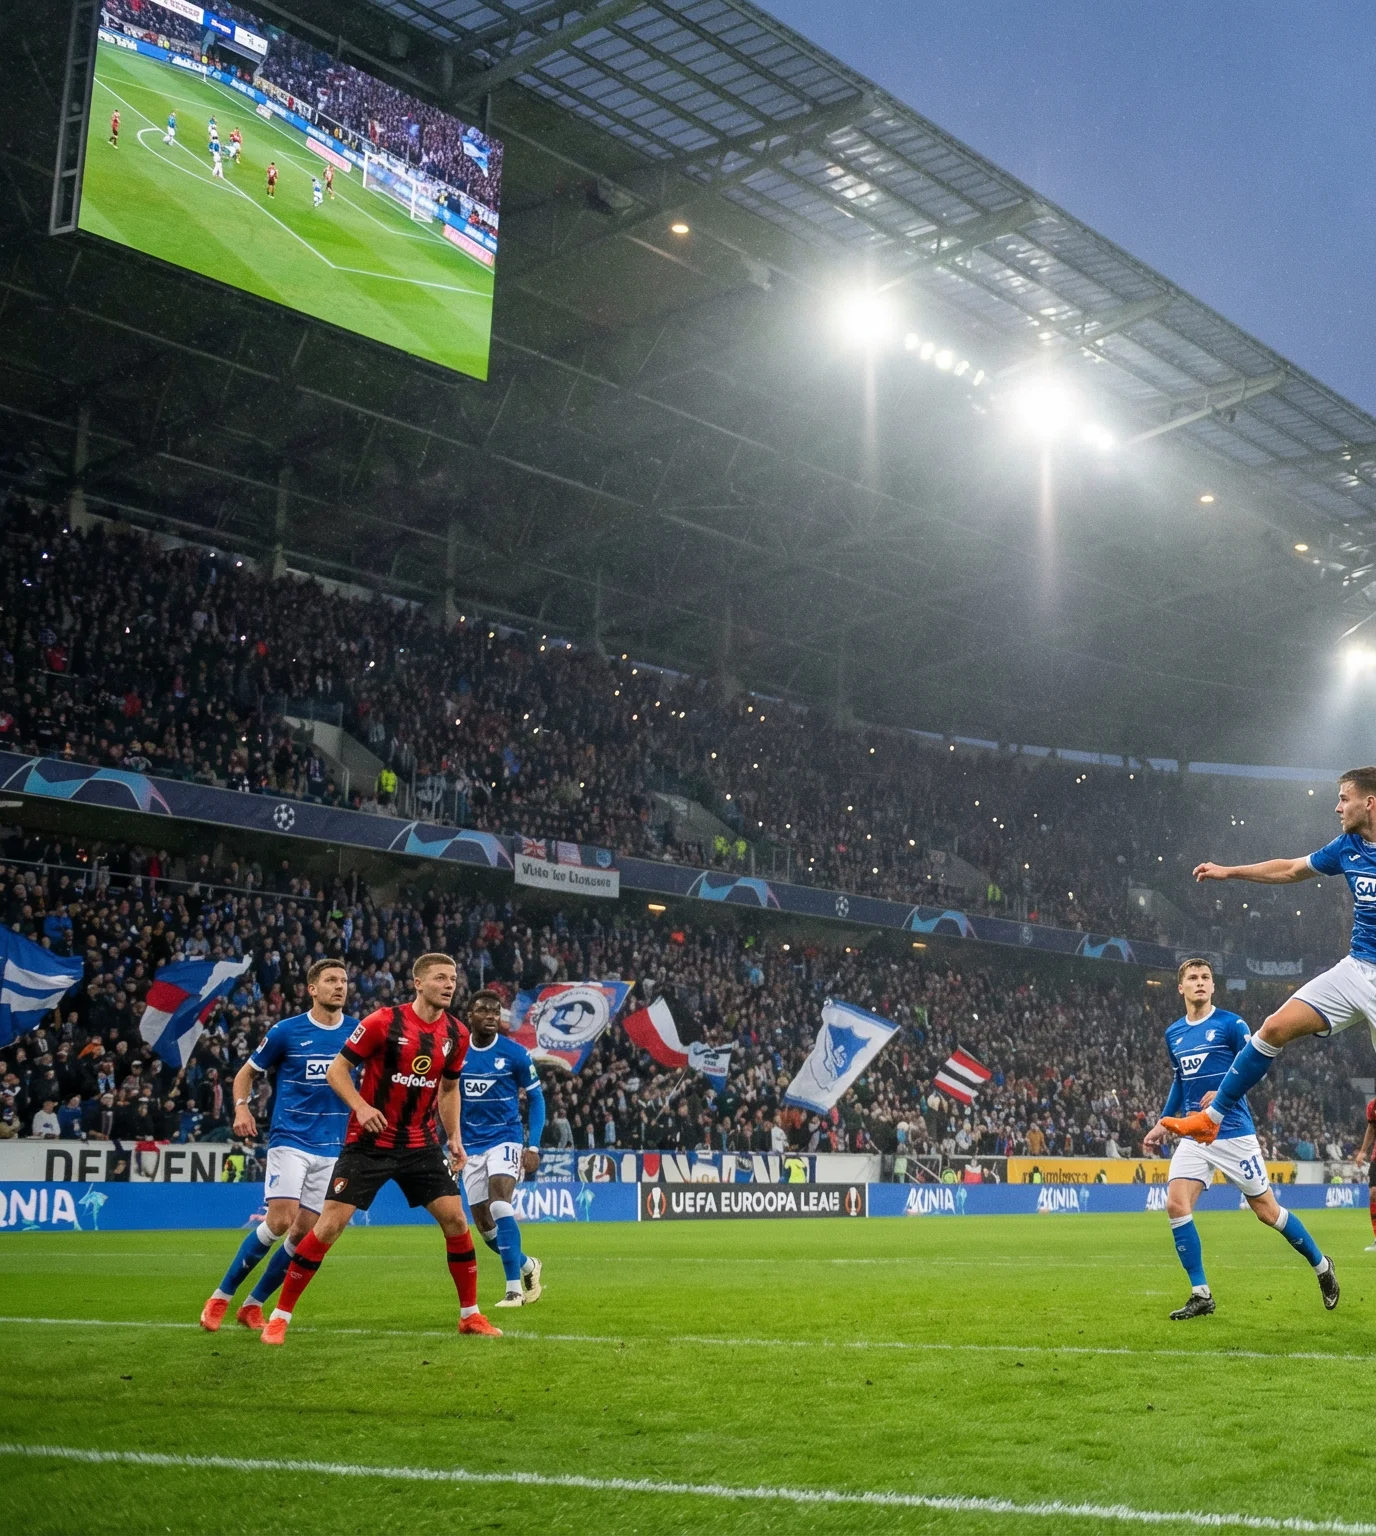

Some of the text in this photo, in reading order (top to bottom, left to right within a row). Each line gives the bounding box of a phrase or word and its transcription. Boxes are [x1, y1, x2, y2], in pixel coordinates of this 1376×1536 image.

[465, 1081, 488, 1094] SAP
[1239, 1154, 1263, 1180] 31
[671, 1191, 718, 1213] UEFA
[720, 1191, 798, 1213] EUROOPA
